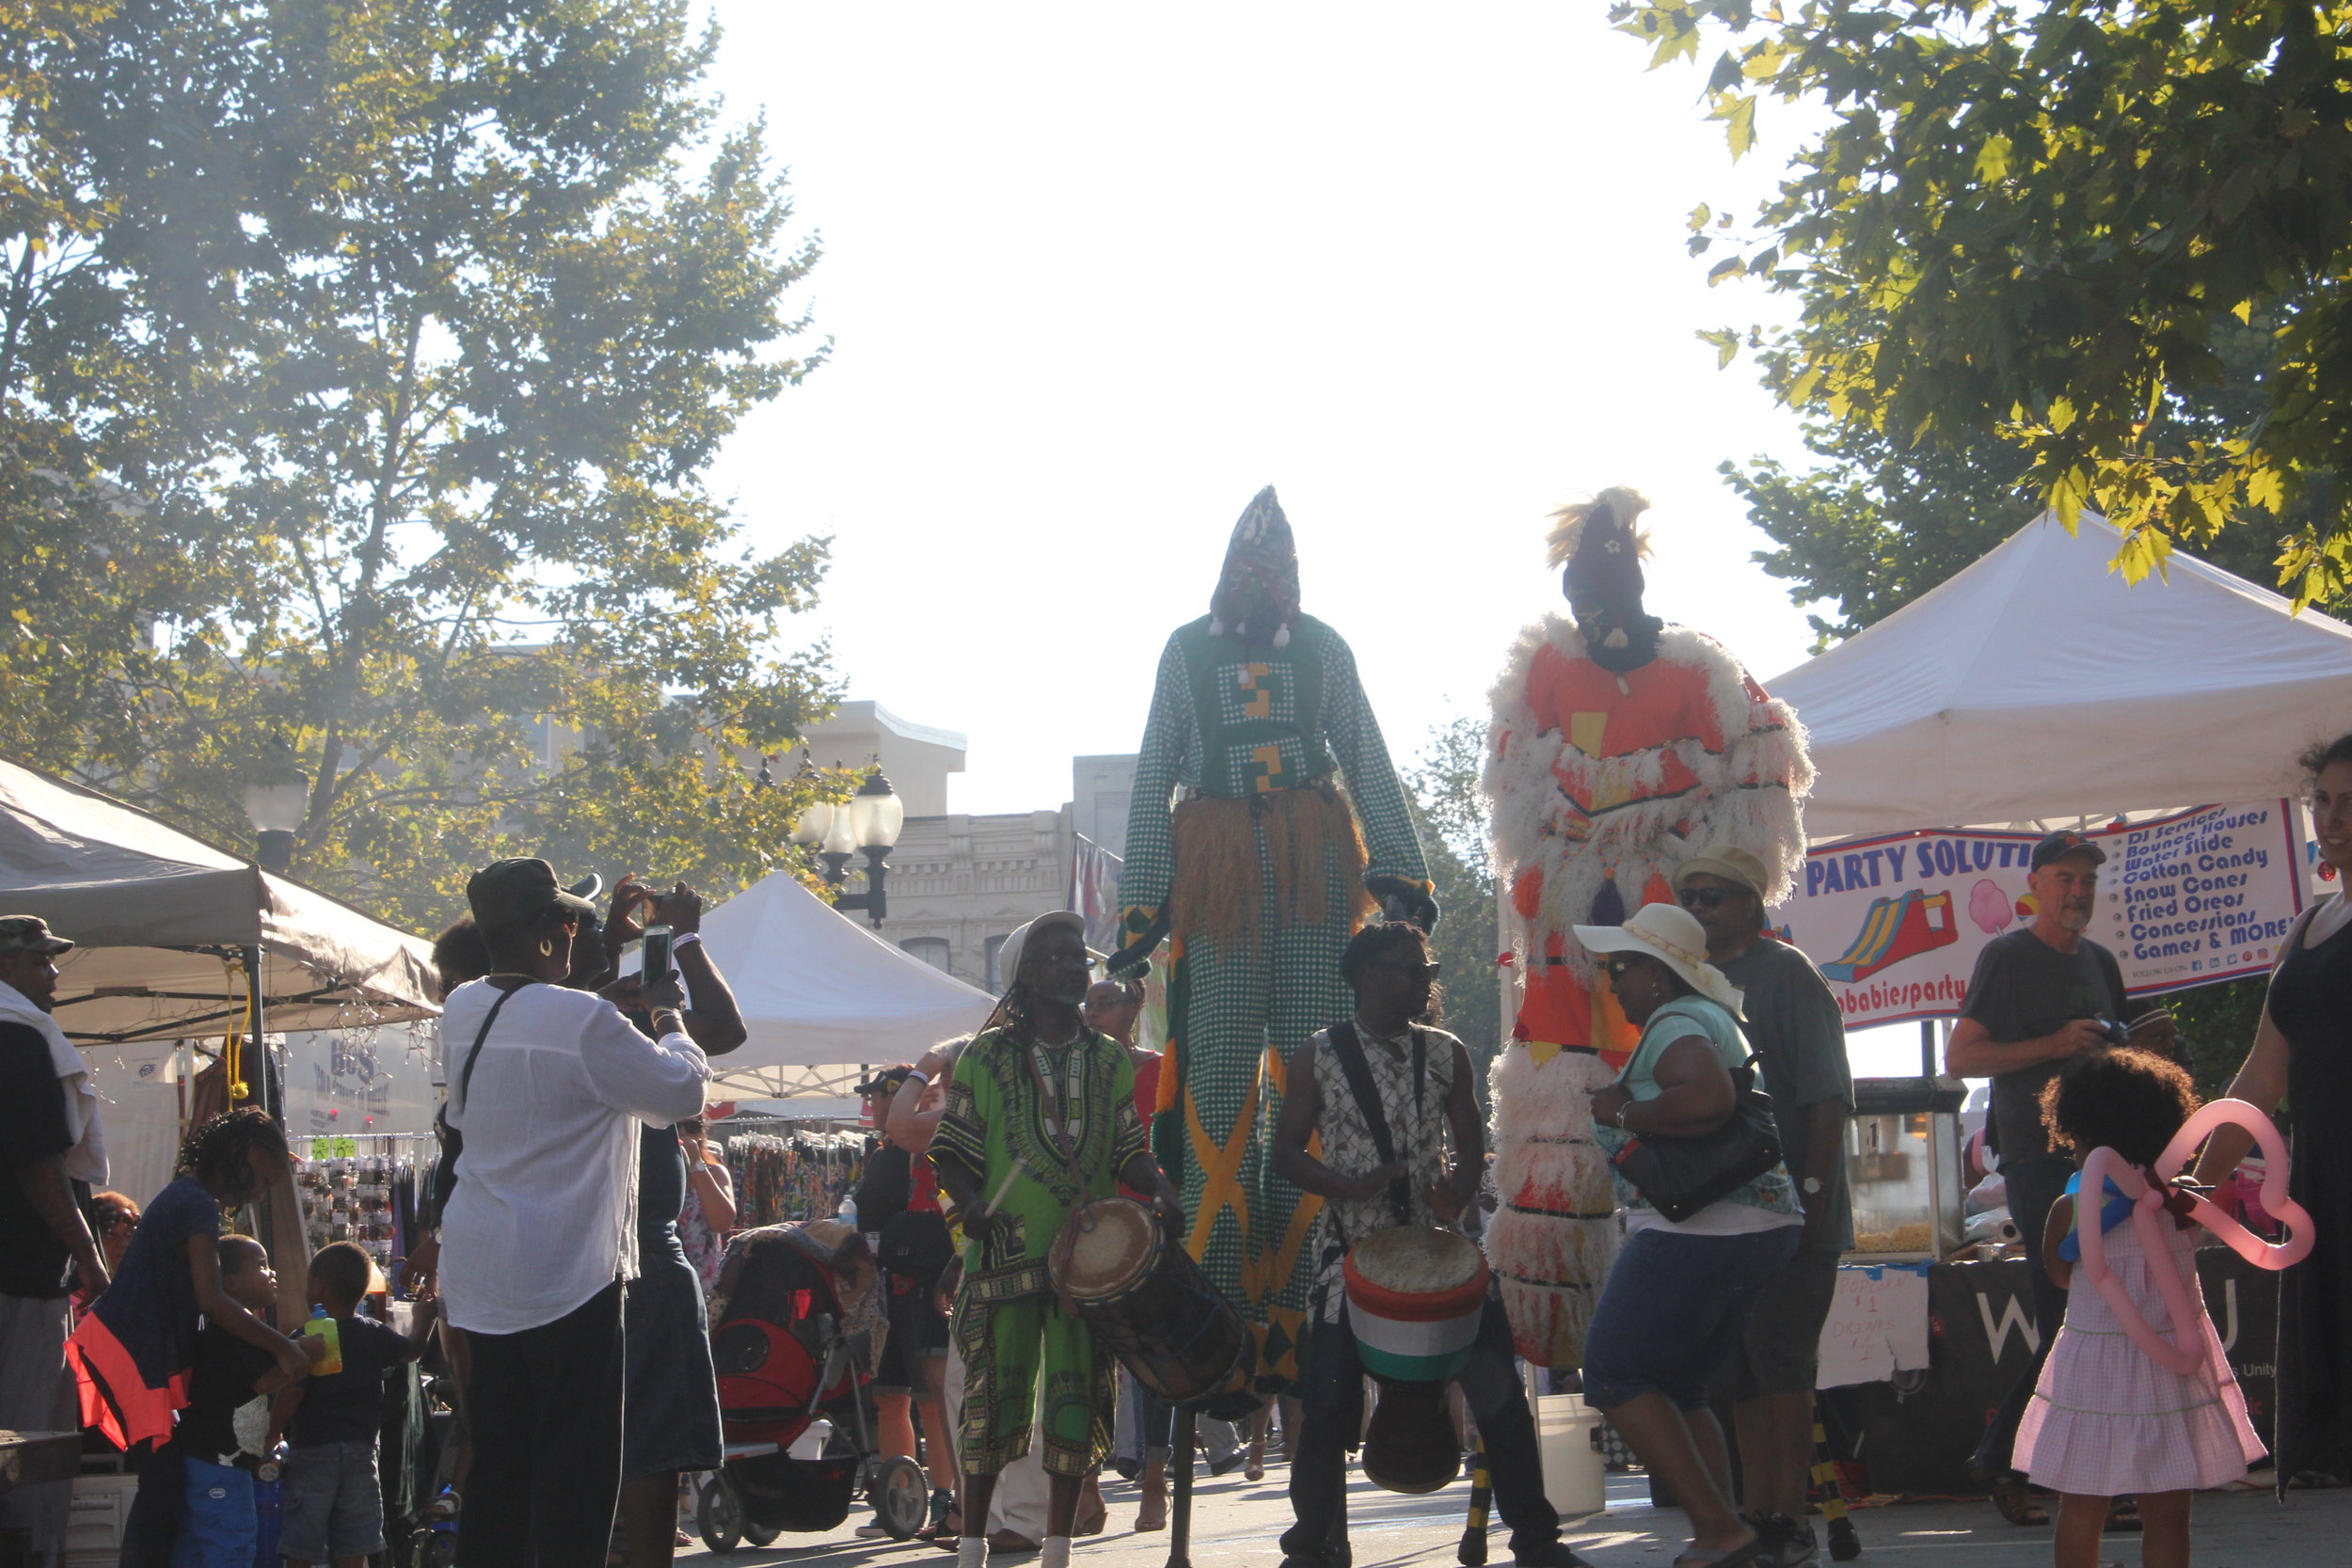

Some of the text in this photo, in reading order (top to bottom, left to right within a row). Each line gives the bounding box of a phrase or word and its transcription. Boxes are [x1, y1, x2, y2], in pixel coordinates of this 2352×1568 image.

[2126, 810, 2268, 860] Bounce Houses
[2127, 807, 2227, 846] DJ Services
[1806, 846, 1907, 896] PARTY
[1916, 839, 2031, 879] SOLUTI
[2122, 847, 2268, 885] Cotton Candy
[2125, 833, 2233, 872] Water Slide
[2124, 873, 2248, 904] Snow Cones
[2127, 894, 2245, 923] Fried Oreos
[2130, 910, 2256, 942] Concessions
[2134, 939, 2201, 960] Games
[2209, 931, 2221, 949] &
[1832, 1319, 1897, 1339] DRINKS
